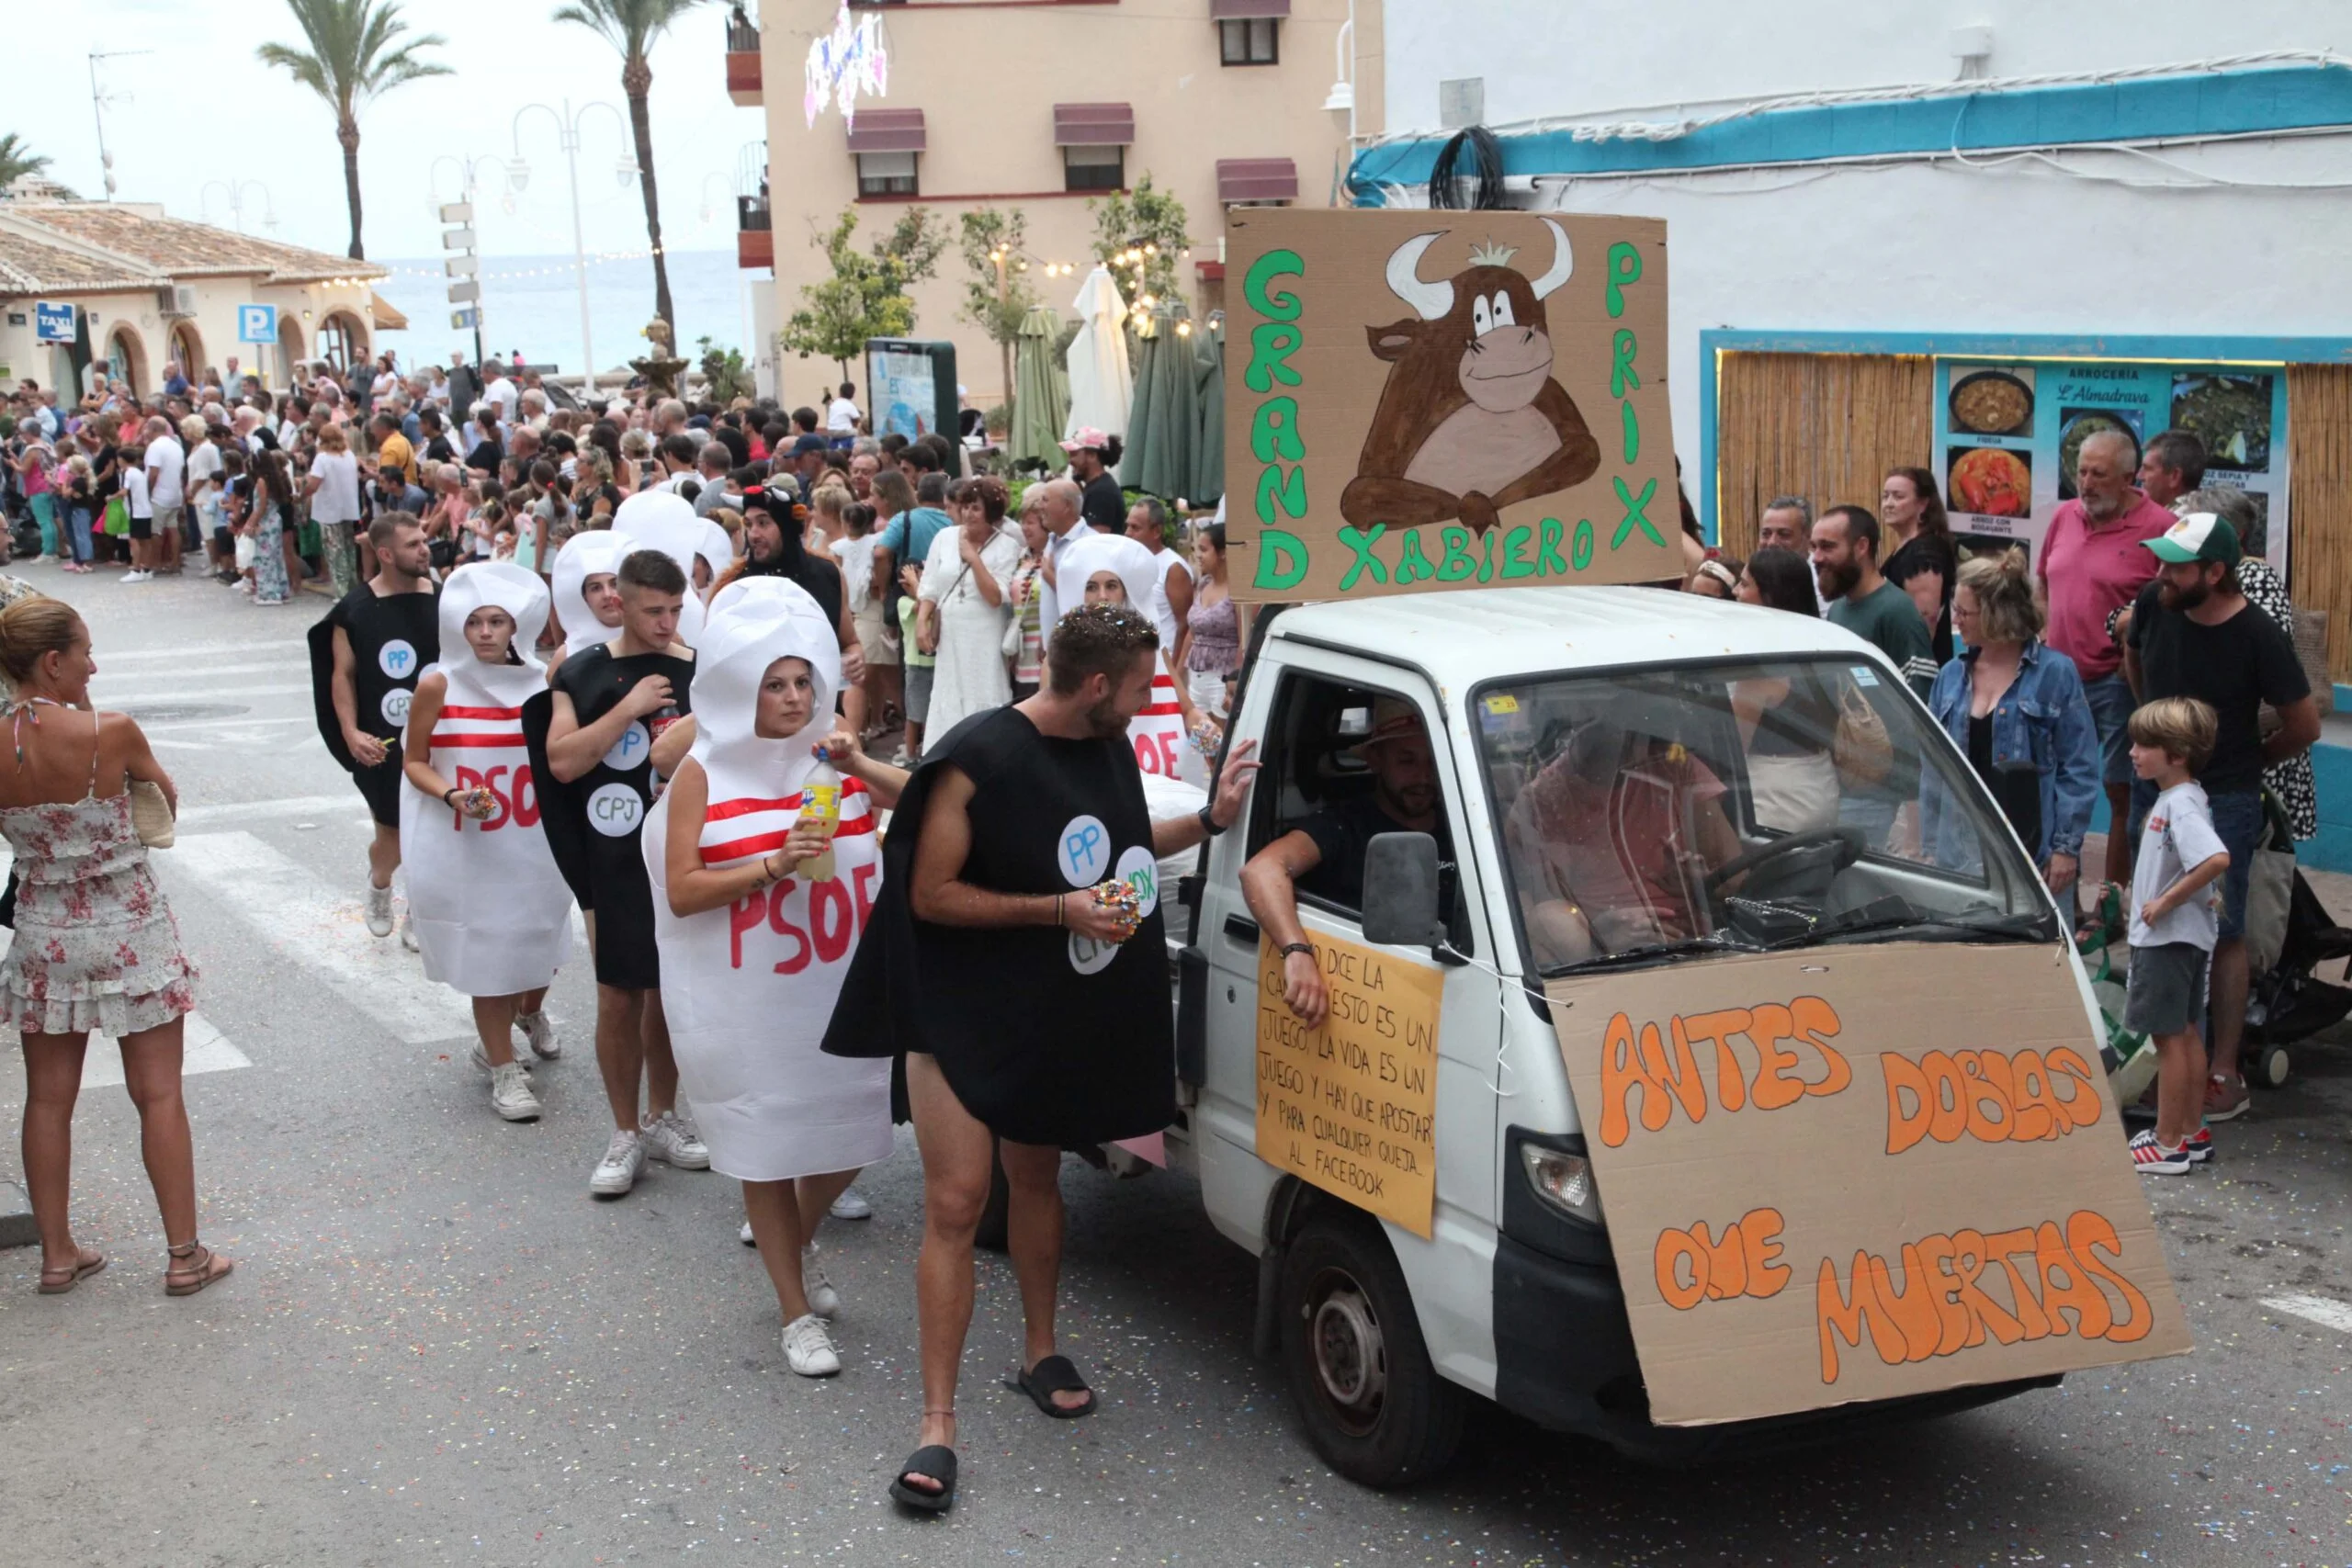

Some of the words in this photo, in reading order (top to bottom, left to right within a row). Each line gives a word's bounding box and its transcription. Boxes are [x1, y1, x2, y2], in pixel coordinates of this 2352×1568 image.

[39, 315, 73, 327] TAXI
[244, 308, 268, 339] P
[1243, 249, 1309, 590] GRAND
[1606, 242, 1667, 551] PRIX
[1338, 516, 1594, 592] XABIERO
[388, 649, 409, 670] PP
[1134, 730, 1182, 782] OE
[454, 764, 542, 832] PSO
[595, 795, 639, 822] CPJ
[1066, 824, 1100, 874] PP
[1129, 863, 1156, 901] OX
[1328, 949, 1357, 982] DICE
[1363, 957, 1385, 992] LA
[1376, 1005, 1396, 1038] ES
[1407, 1016, 1433, 1054] UN
[1259, 1051, 1304, 1094] JUEGO
[1311, 1073, 1318, 1099] Y
[1326, 1079, 1347, 1111] HAY
[1351, 1091, 1374, 1122] QUE
[1318, 1030, 1336, 1065] LA
[1340, 1039, 1372, 1076] VIDA
[1379, 1052, 1397, 1083] ES
[1404, 1062, 1425, 1095] UN
[1599, 996, 1852, 1148] ANTES
[1260, 1090, 1270, 1117] Y
[1278, 1099, 1306, 1133] PARA
[1313, 1115, 1373, 1158] CUALQUIER
[1881, 1046, 2102, 1155] DOBLAS
[1289, 1140, 1306, 1167] AL
[1316, 1149, 1384, 1198] FACEBOOK
[1655, 1207, 1792, 1311] QUE
[1816, 1210, 2154, 1385] MUERTAS
